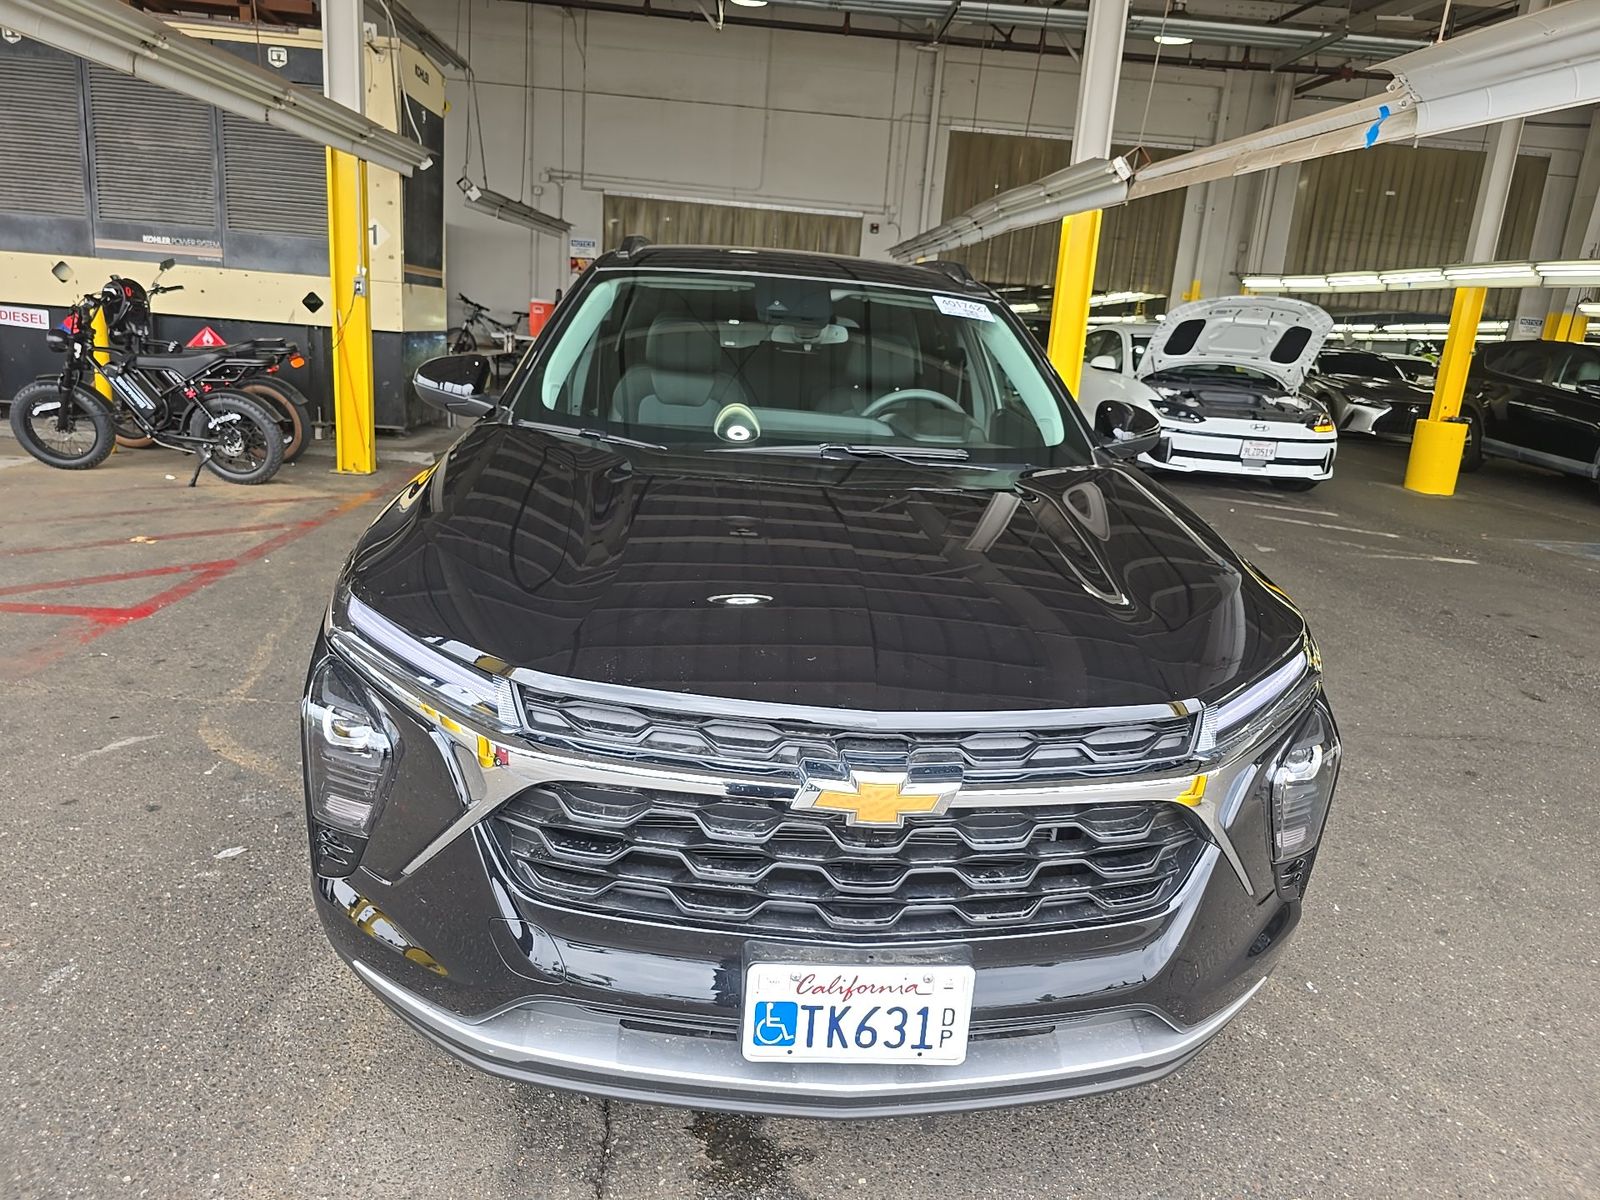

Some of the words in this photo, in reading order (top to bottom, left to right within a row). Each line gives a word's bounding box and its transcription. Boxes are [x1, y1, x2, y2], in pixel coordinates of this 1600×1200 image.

[142, 234, 170, 244] KOHLER
[0, 310, 47, 325] DIESEL
[796, 973, 933, 1001] California
[800, 1005, 933, 1050] TK631
